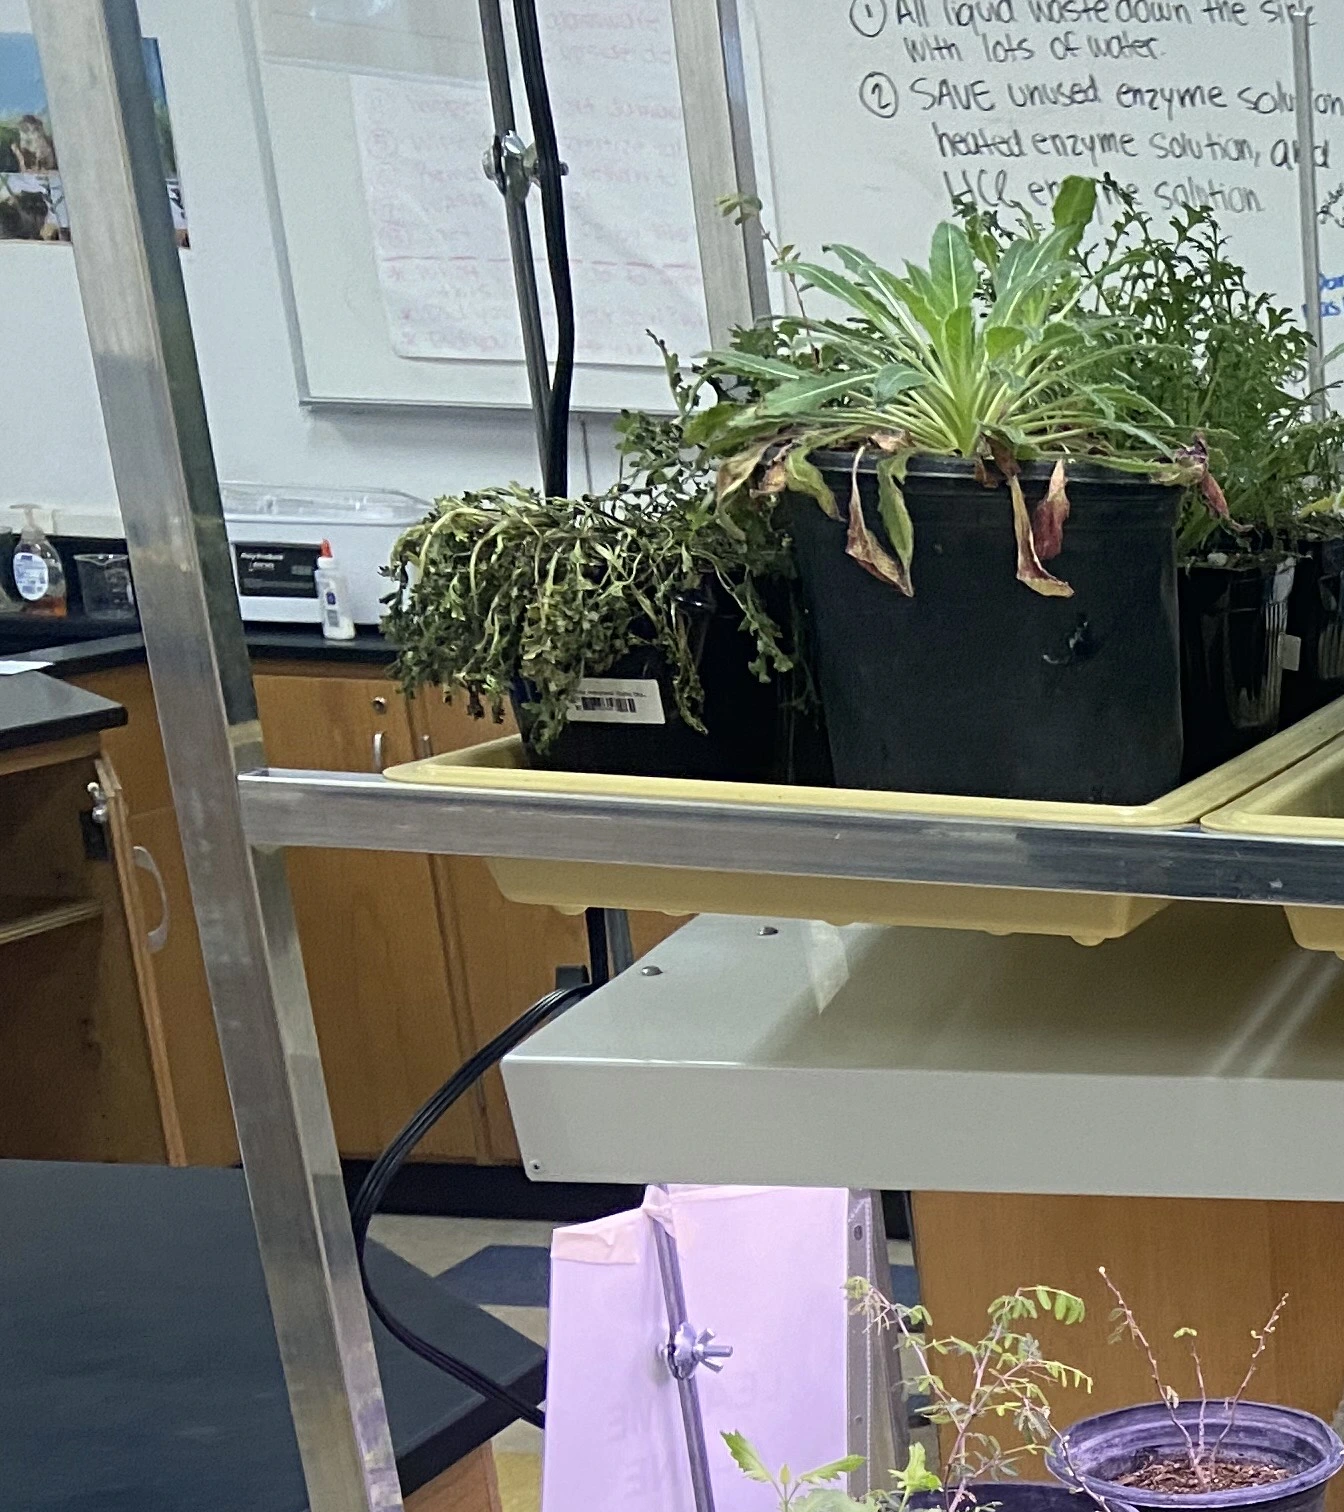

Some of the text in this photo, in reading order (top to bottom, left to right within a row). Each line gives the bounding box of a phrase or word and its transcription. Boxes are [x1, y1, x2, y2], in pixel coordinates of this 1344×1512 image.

[903, 36, 963, 63] with
[982, 33, 1034, 64] lots
[1050, 33, 1080, 62] of
[910, 76, 996, 112] SAVE
[1007, 74, 1101, 108] unused
[1116, 82, 1229, 121] enzyme
[931, 121, 1024, 160] heated
[1034, 130, 1138, 168] enzyme
[1147, 130, 1261, 168] solution,
[1154, 176, 1267, 213] solution
